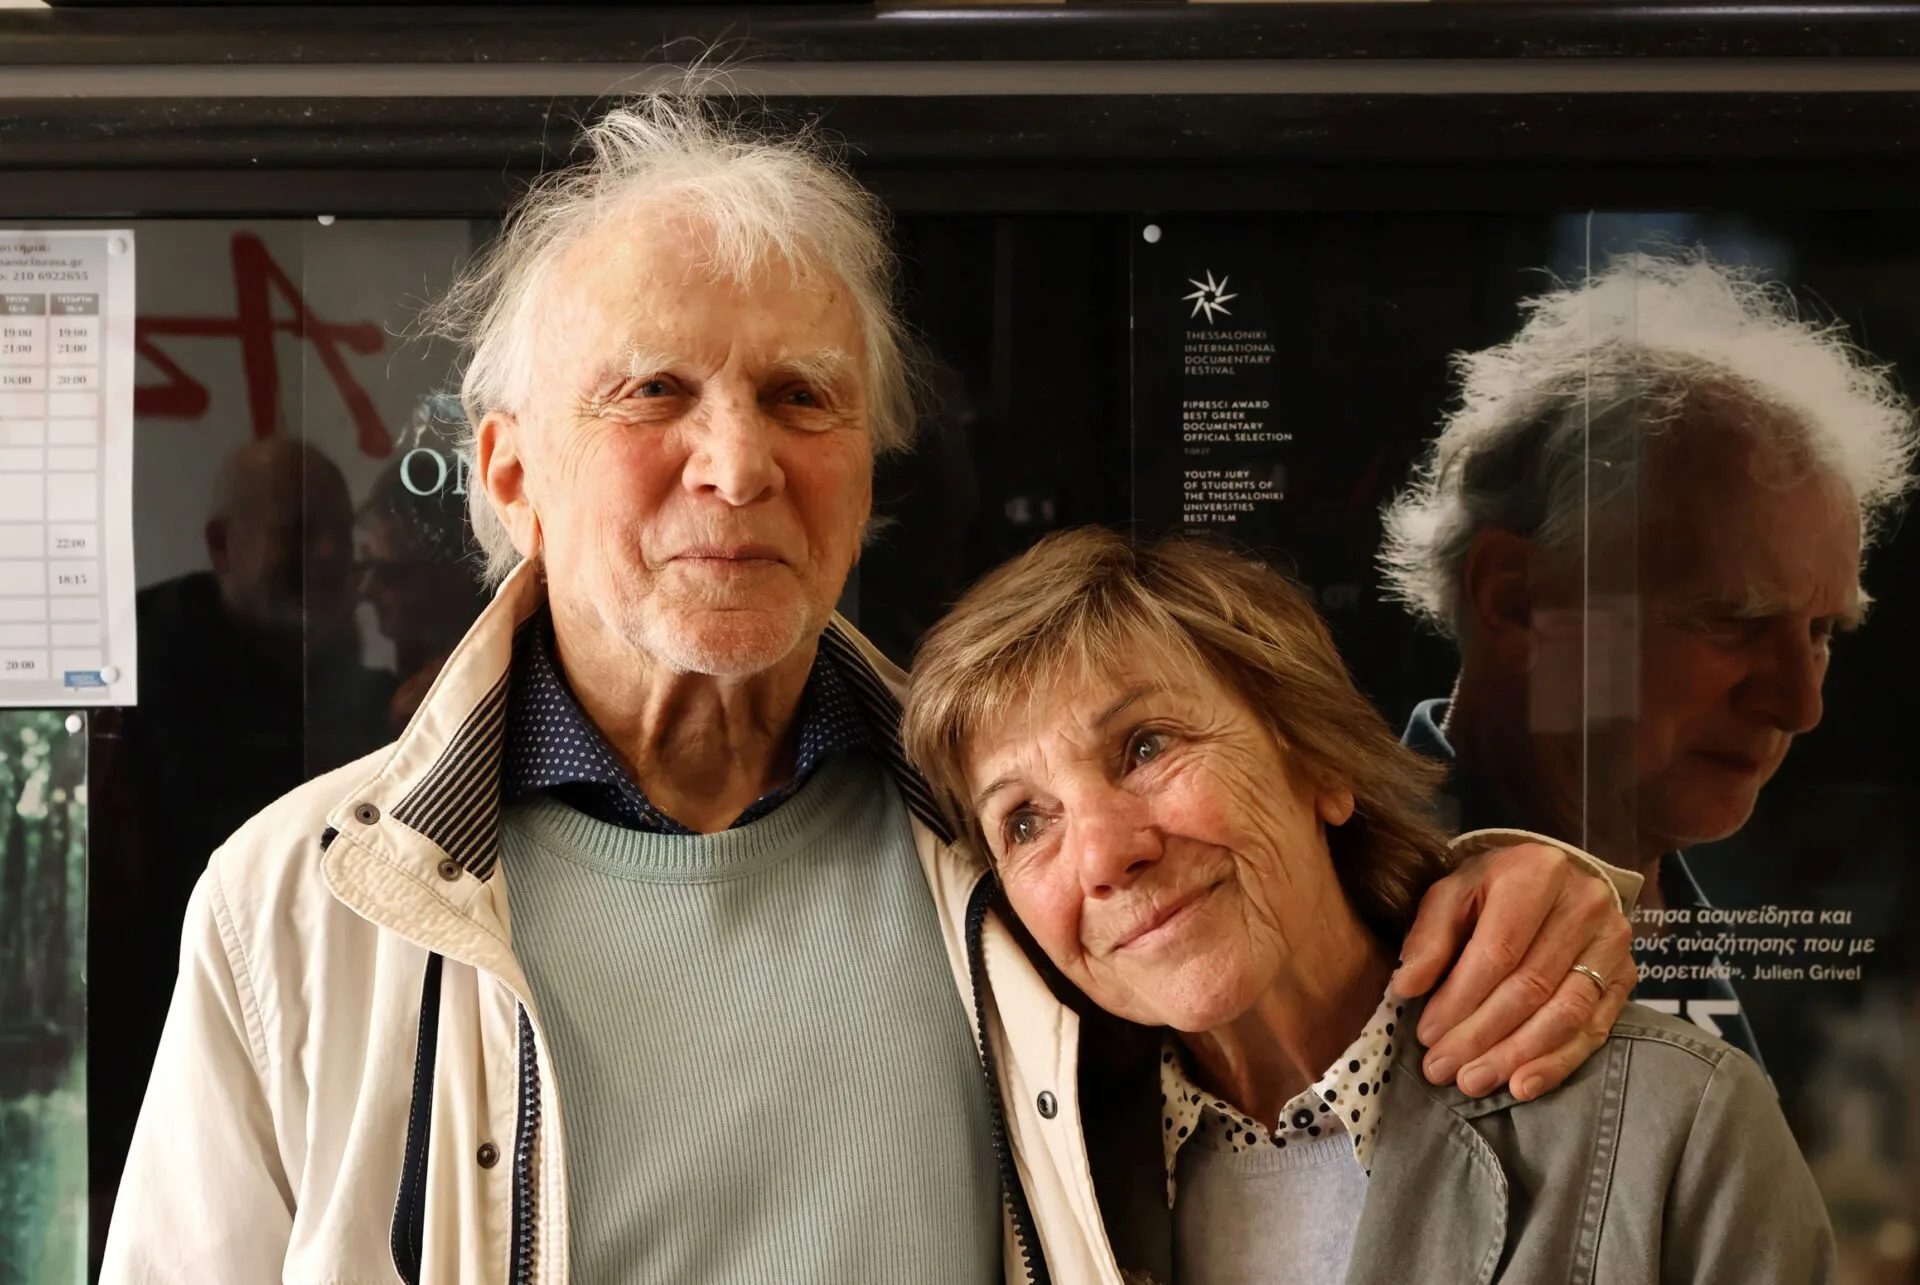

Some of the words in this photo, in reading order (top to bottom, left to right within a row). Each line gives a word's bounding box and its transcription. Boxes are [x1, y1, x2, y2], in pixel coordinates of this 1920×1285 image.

[13, 271, 34, 281] 210
[3, 328, 33, 338] 19:00
[58, 328, 88, 338] 19:00
[1186, 331, 1267, 340] THESSALONIKI
[2, 344, 33, 354] 21:00
[57, 344, 88, 354] 21:00
[1184, 343, 1276, 353] INTERNATIONAL
[1184, 355, 1271, 365] DOCUMENTARY
[1184, 365, 1236, 375] FESTIVAL
[3, 375, 33, 385] 18:00
[57, 375, 87, 385] 20:00
[1182, 400, 1228, 409] FIPRESCI
[1231, 400, 1270, 409] AWARD
[1182, 411, 1208, 420] BEST
[1211, 411, 1246, 420] GREEK
[1182, 422, 1264, 431] DOCUMENTARY
[1183, 433, 1231, 442] OFFICIAL
[1234, 433, 1293, 442] SELECTION
[1184, 470, 1221, 479] YOUTH
[1224, 470, 1250, 479] JURY
[1183, 481, 1198, 490] OF
[1201, 481, 1256, 490] STUDENTS
[1258, 481, 1274, 490] OF
[1184, 491, 1204, 501] THE
[1207, 491, 1284, 501] THESSALONIKI
[1183, 502, 1255, 512] UNIVERSITIES
[1183, 513, 1209, 522] BEST
[1211, 513, 1237, 522] FILM
[56, 538, 86, 548] 22:00
[58, 575, 87, 584] 18:15
[5, 660, 35, 670] 20:00
[1630, 905, 1692, 928] έτησα
[1697, 904, 1814, 928] ασυνείδητα
[1819, 909, 1852, 925] και
[1629, 932, 1671, 955] ούς
[1676, 932, 1797, 955] αναζήτησης
[1803, 938, 1844, 952] που
[1848, 938, 1876, 956] με
[1637, 961, 1746, 982] φορετικά».
[1752, 964, 1804, 981] Julien
[1809, 964, 1861, 981] Grivel
